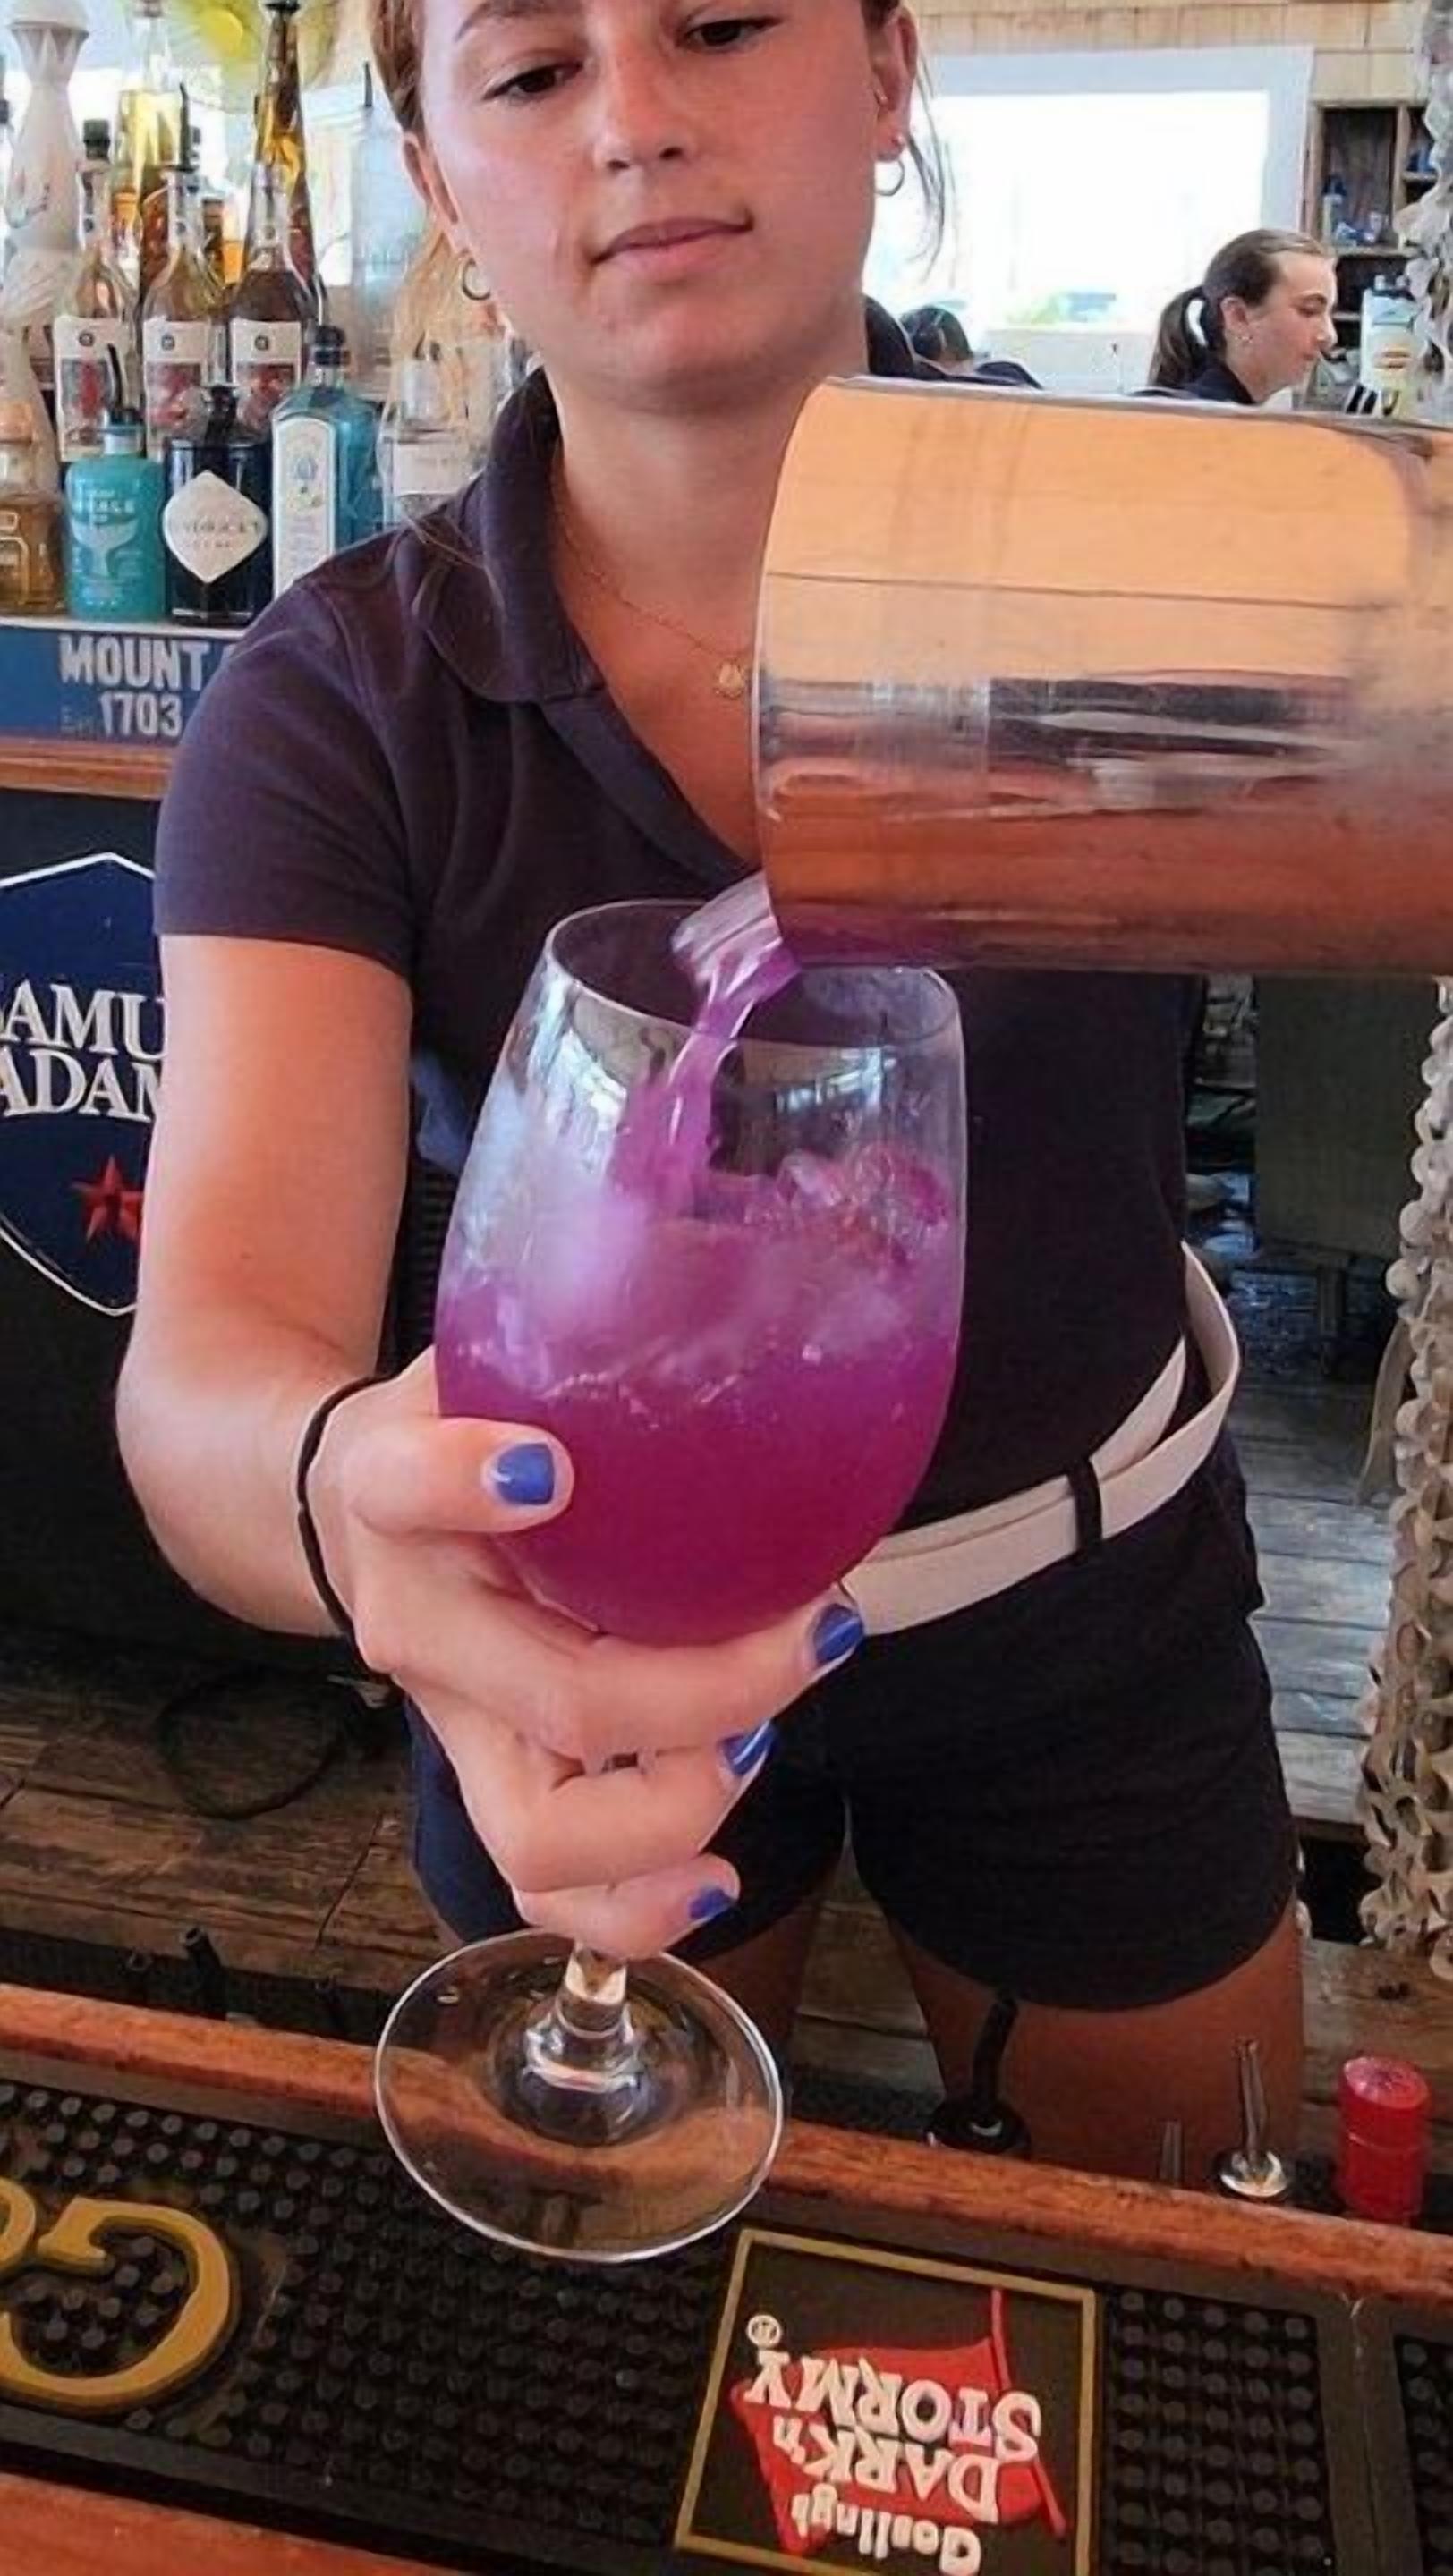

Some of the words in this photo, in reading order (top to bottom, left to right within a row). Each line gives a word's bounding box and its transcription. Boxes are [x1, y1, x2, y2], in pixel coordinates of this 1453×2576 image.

[59, 634, 210, 691] MOUNT
[99, 691, 182, 737] 1703
[0, 979, 168, 1060] AMU
[743, 2350, 1042, 2462] STORMY
